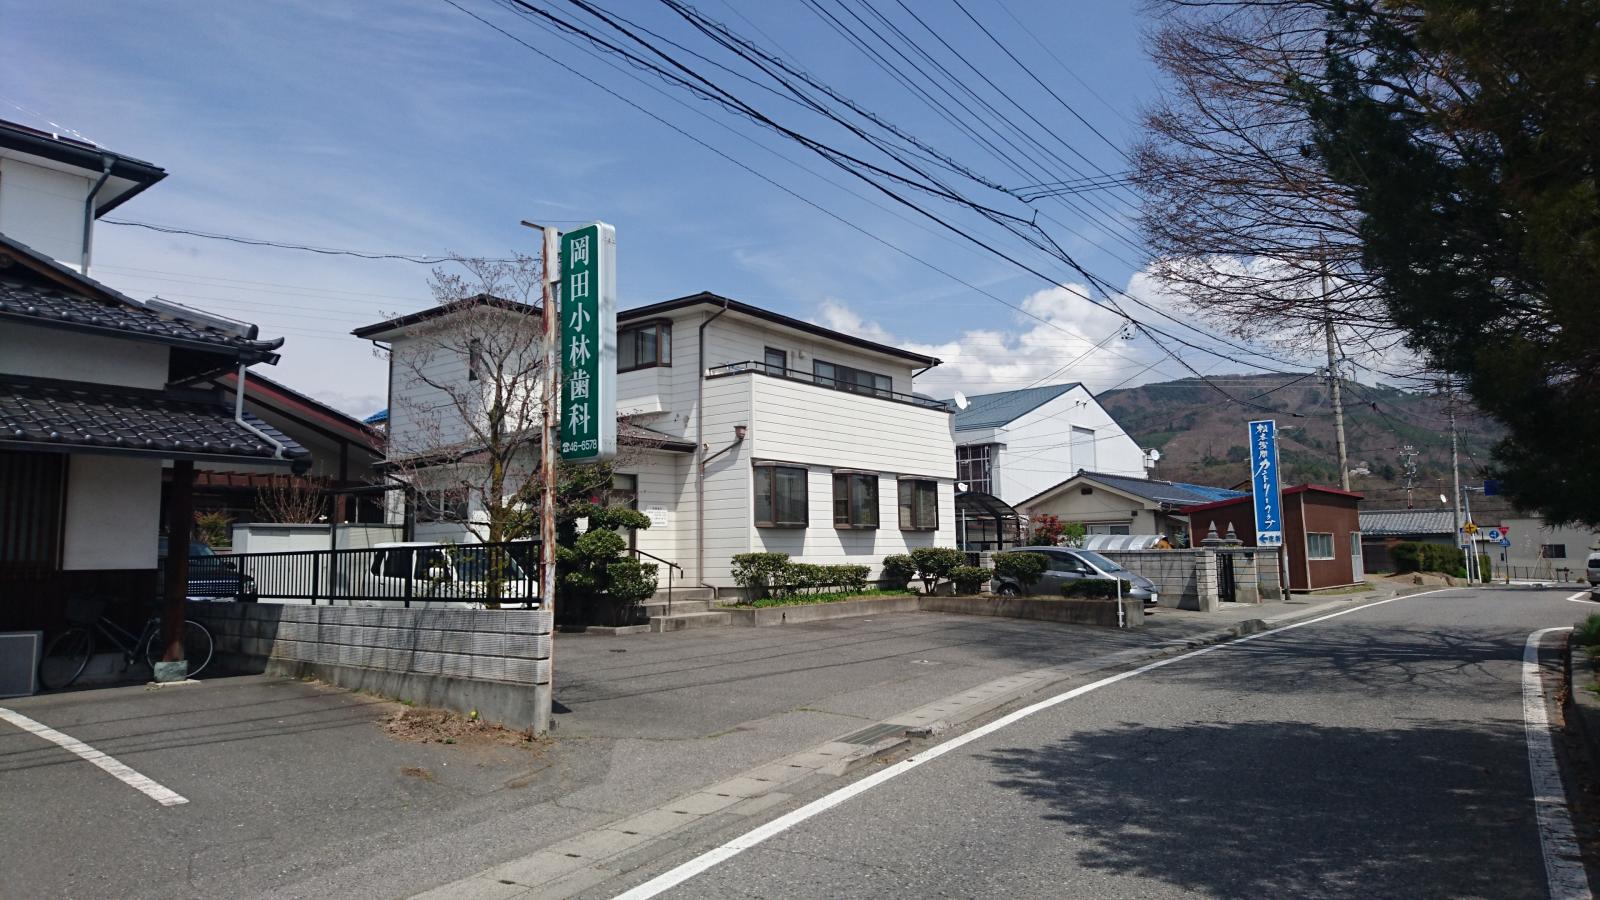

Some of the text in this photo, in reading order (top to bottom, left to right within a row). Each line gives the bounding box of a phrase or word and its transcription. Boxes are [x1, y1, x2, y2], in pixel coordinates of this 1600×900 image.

[568, 234, 591, 436] 岡田小林歯科
